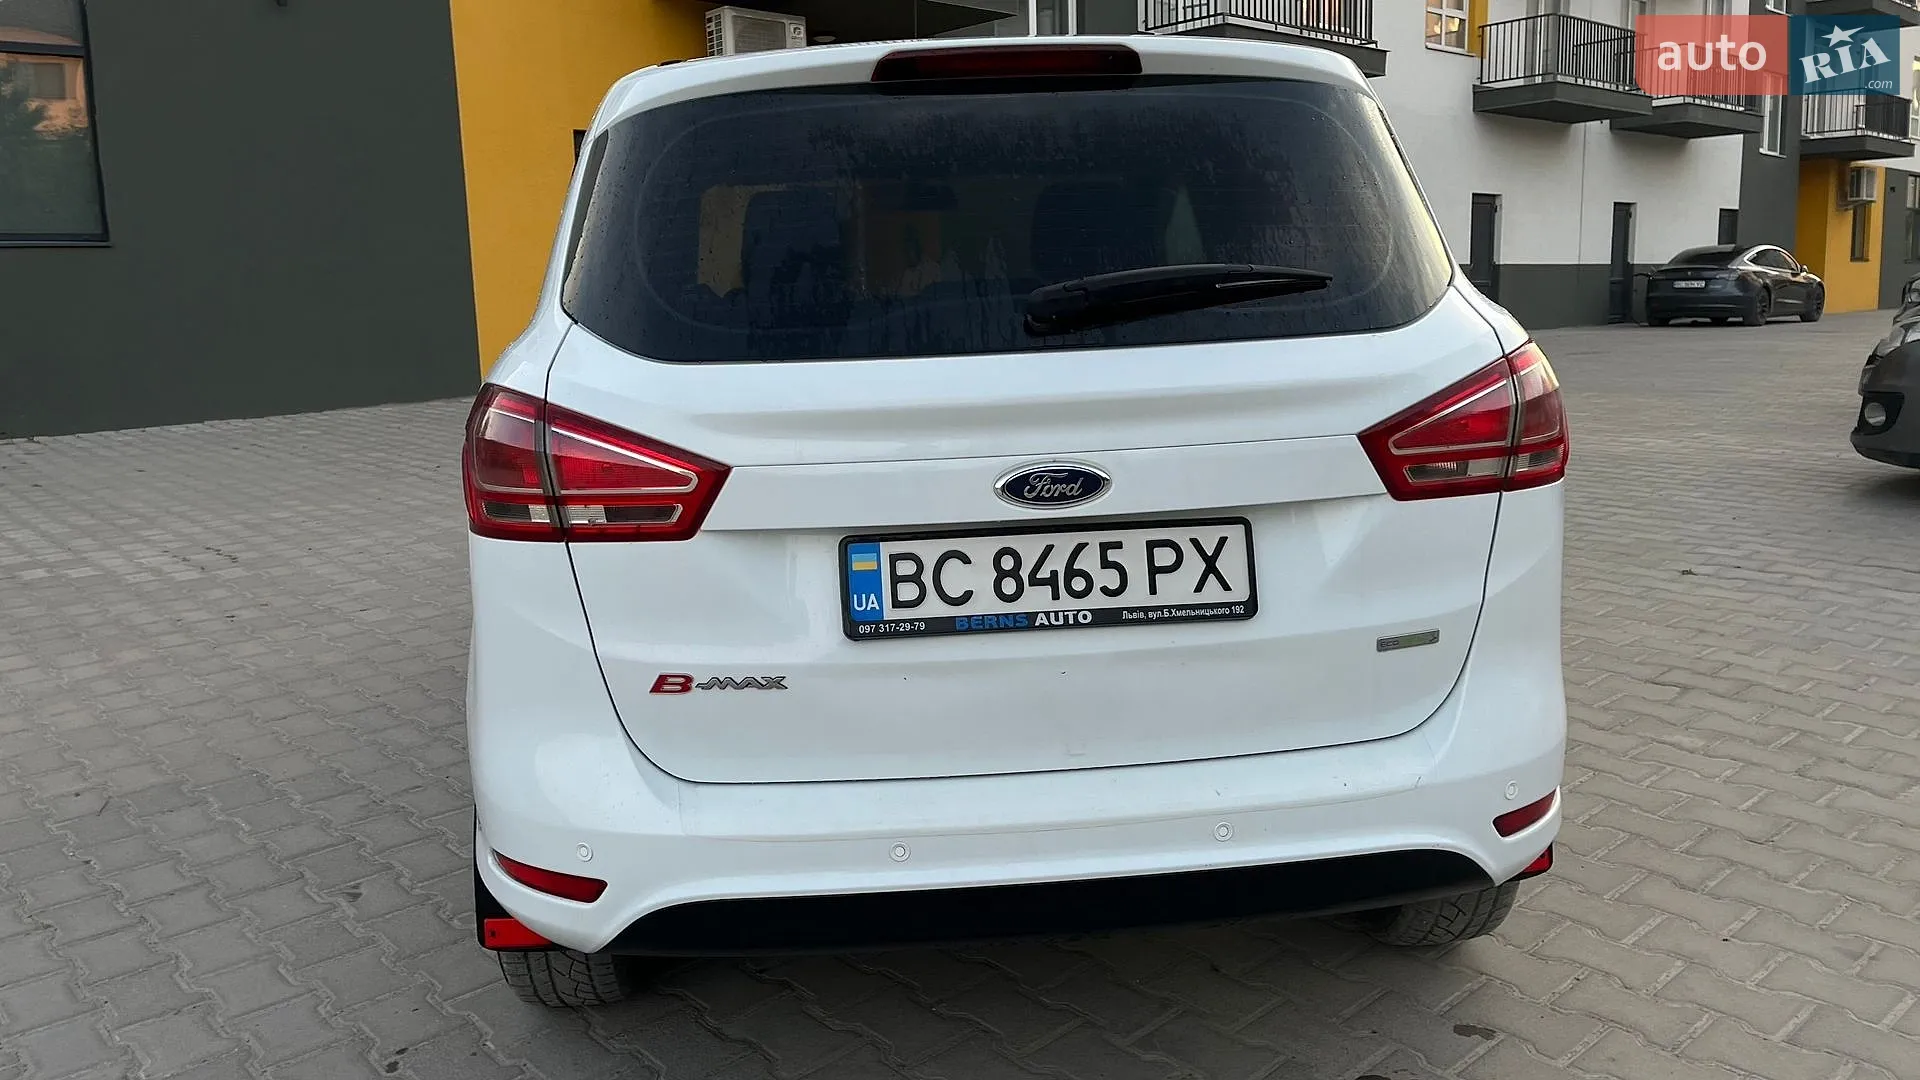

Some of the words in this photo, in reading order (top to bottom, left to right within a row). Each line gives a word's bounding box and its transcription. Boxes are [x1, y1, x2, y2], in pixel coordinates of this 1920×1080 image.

[1023, 471, 1086, 499] Ford
[888, 549, 974, 609] BC
[992, 540, 1129, 603] 8465
[1146, 536, 1233, 596] PX
[853, 593, 880, 611] UA
[1122, 610, 1147, 620] Львів,
[1231, 605, 1245, 614] 192
[858, 624, 876, 634] 097
[878, 621, 926, 633] 317-29-79
[955, 614, 1029, 631] BERNS
[1034, 609, 1093, 626] AUTO
[649, 672, 789, 695] B-MAX
